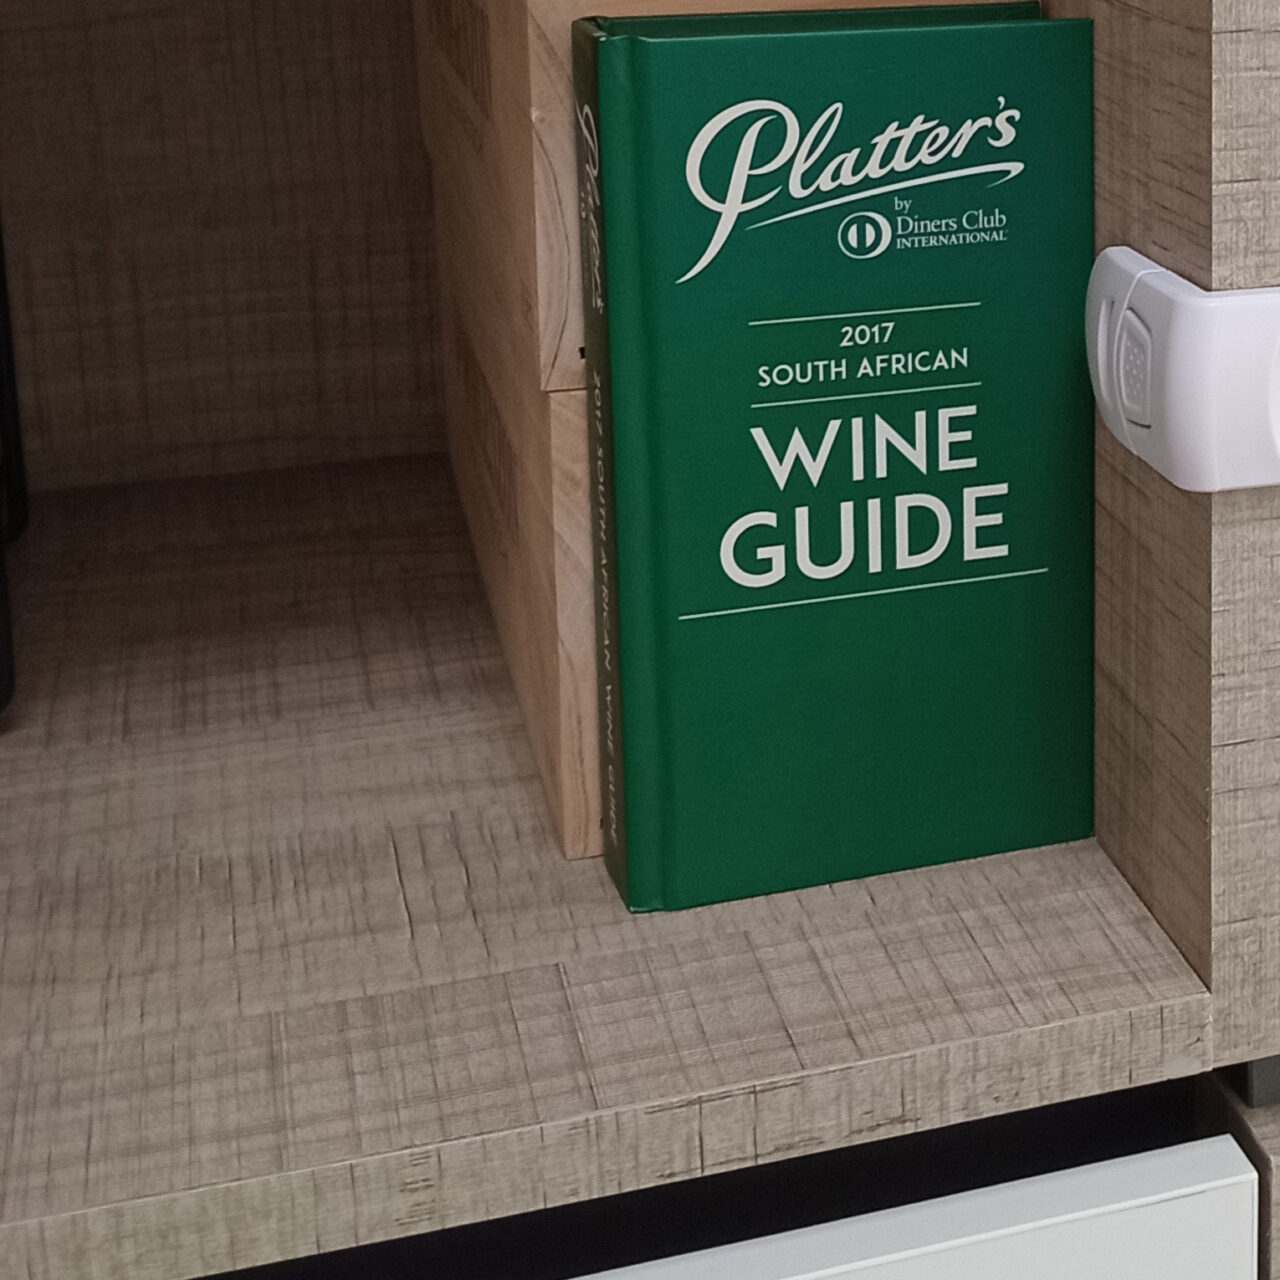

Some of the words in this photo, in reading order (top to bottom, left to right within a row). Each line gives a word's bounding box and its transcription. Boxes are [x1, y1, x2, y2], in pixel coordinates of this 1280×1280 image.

[675, 95, 1022, 284] Platter's
[894, 196, 912, 214] by
[896, 214, 957, 236] Diners
[962, 208, 1007, 230] Club
[896, 230, 1007, 250] INTERNATIONAL
[838, 321, 896, 347] 2017
[758, 358, 847, 387] SOUTH
[856, 347, 969, 378] AFRICAN
[749, 404, 978, 491] WINE
[719, 482, 1009, 588] GUIDE
